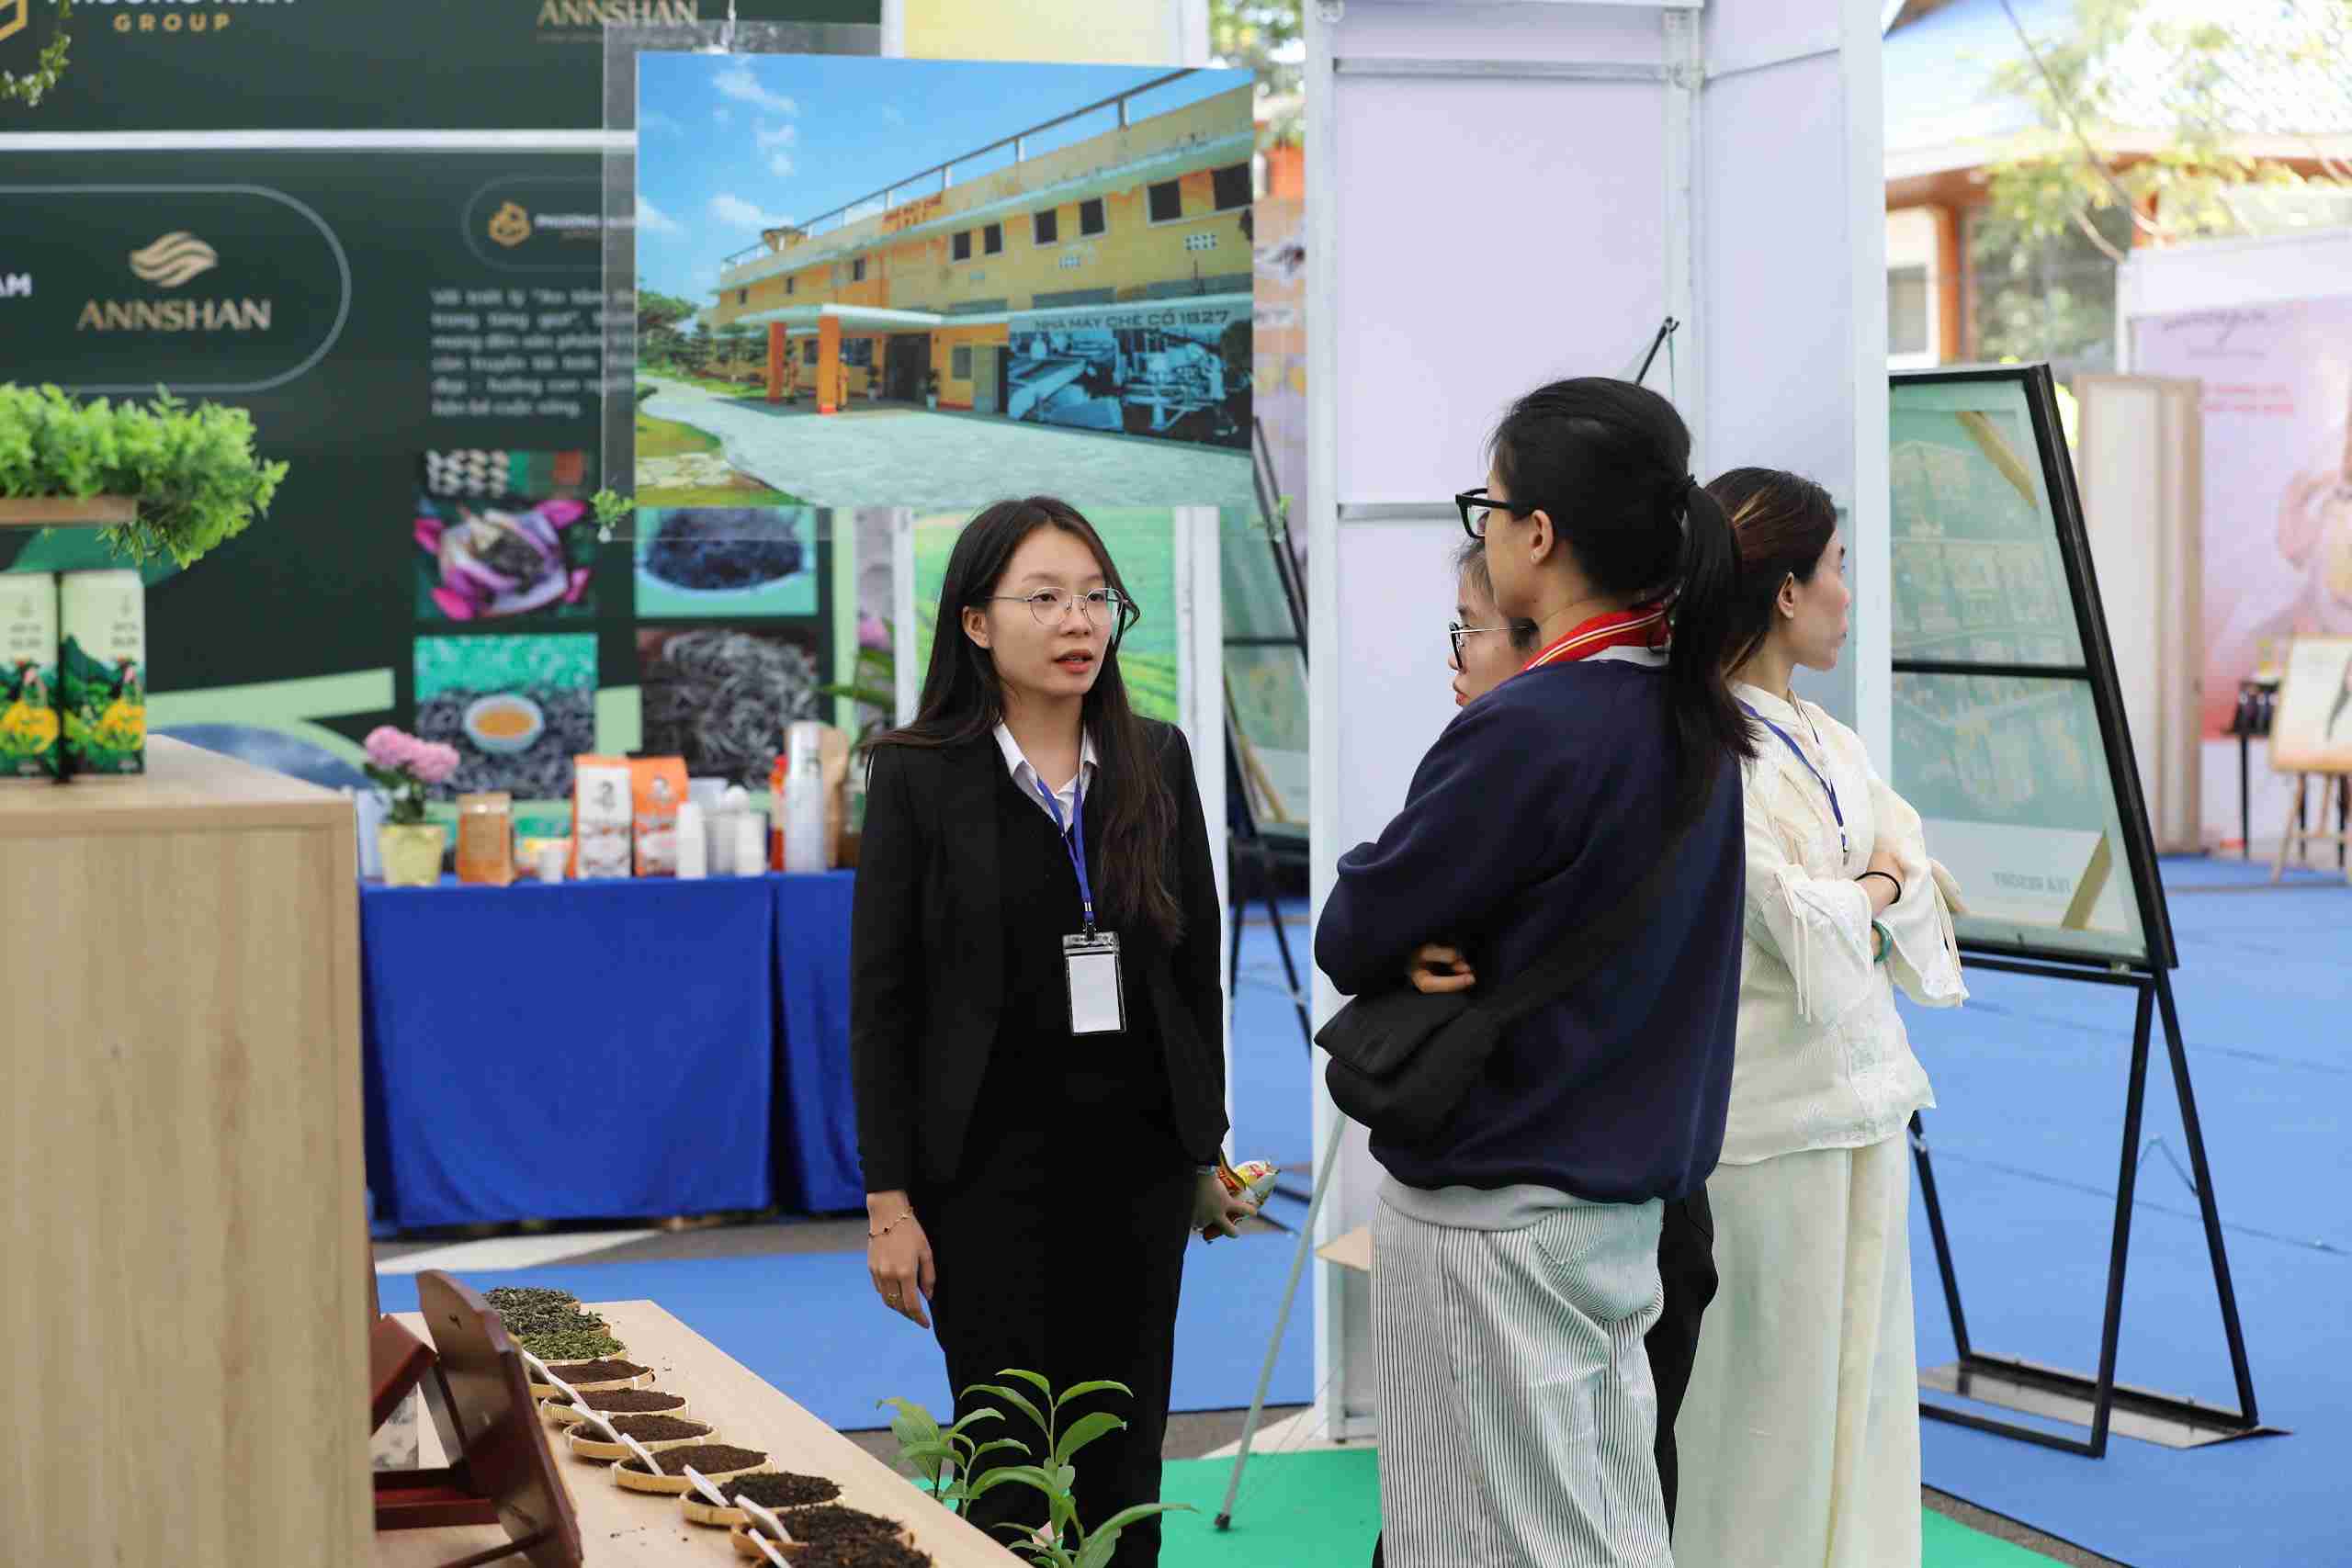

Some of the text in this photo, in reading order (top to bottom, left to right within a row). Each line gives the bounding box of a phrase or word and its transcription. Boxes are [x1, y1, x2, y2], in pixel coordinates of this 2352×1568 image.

[113, 14, 231, 31] GROUP
[536, 0, 698, 28] ANNSHAN
[76, 298, 271, 332] ANNSHAN
